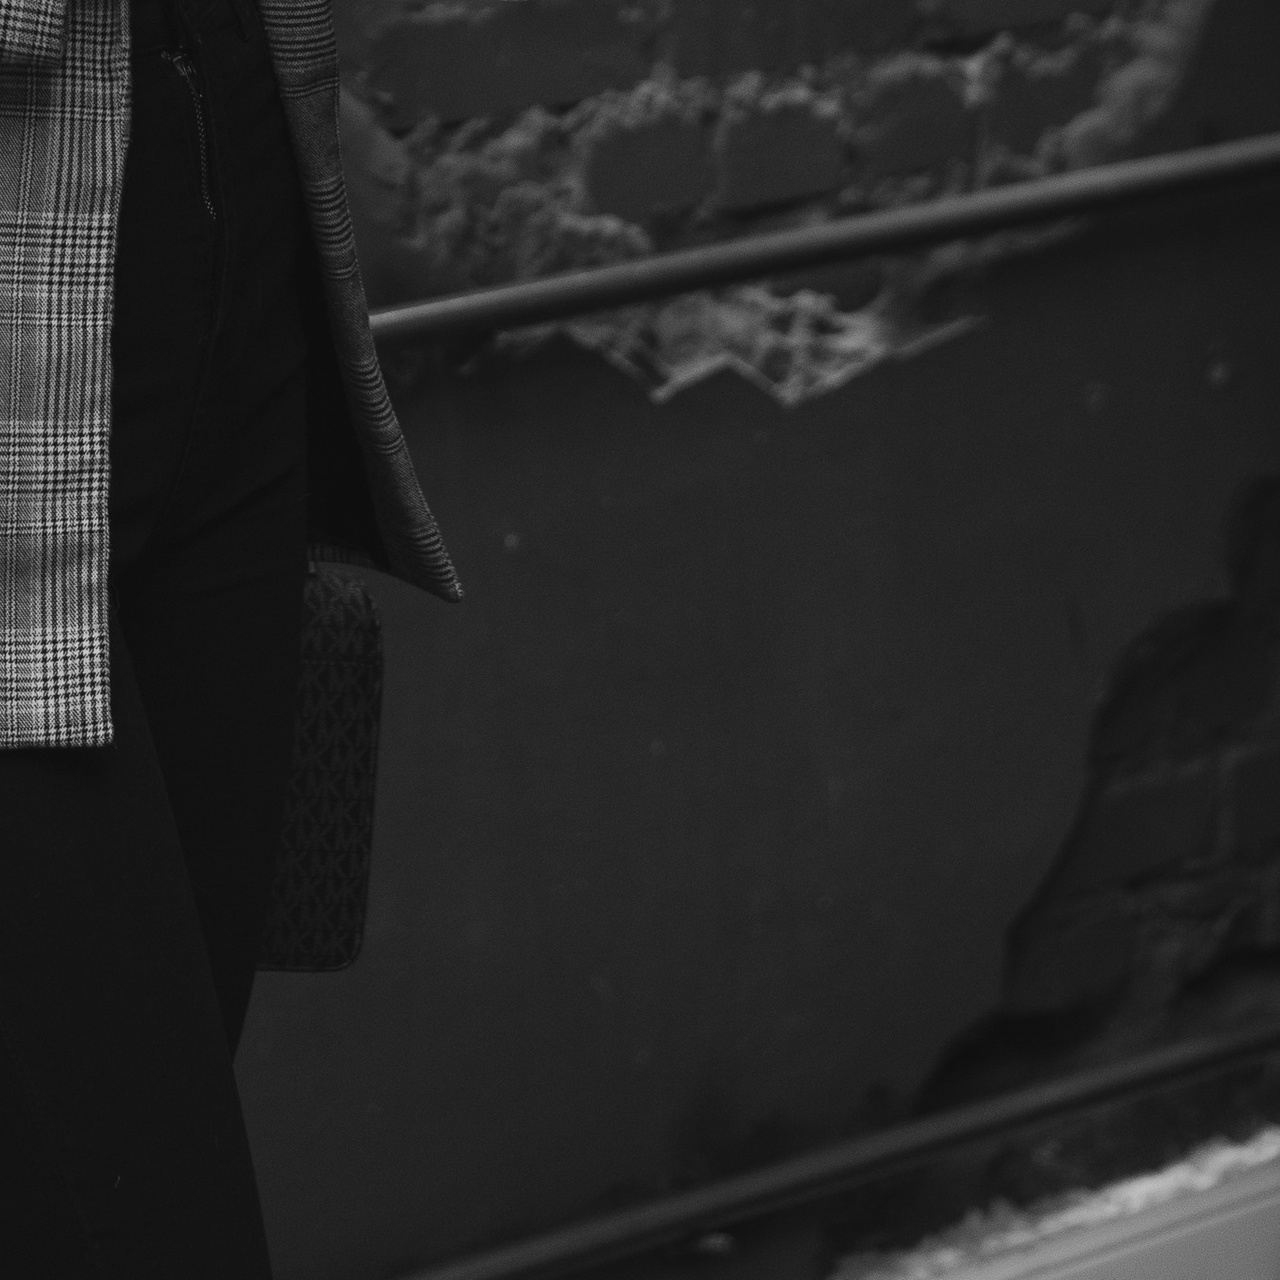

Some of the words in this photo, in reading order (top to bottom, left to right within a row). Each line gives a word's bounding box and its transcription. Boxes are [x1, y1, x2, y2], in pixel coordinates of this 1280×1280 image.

[302, 692, 339, 718] MK
[317, 719, 352, 746] MK
[291, 744, 329, 770] MK
[331, 746, 366, 773] MK
[306, 771, 342, 797] MK
[321, 798, 357, 825] MK
[295, 824, 332, 850] MK
[335, 825, 370, 852] MK
[310, 851, 347, 878] MK
